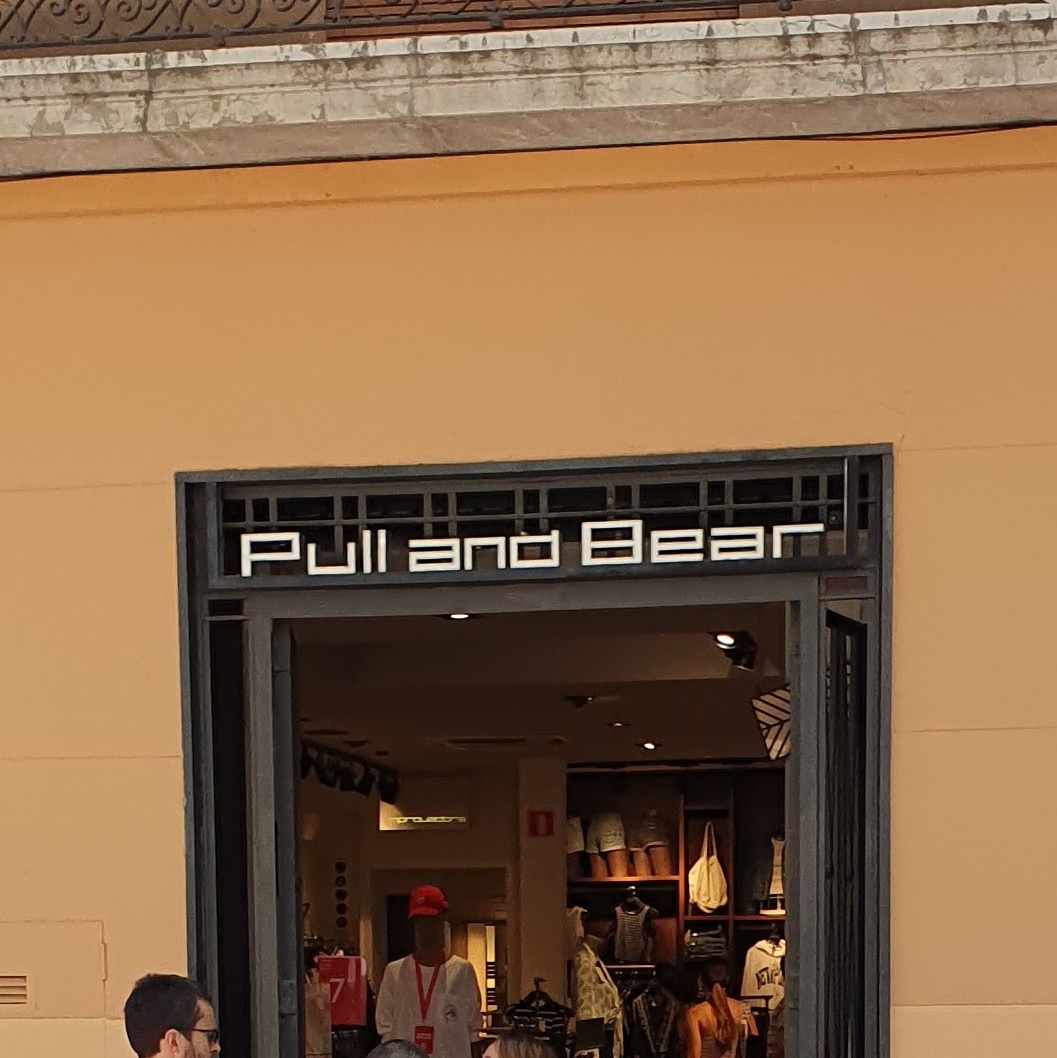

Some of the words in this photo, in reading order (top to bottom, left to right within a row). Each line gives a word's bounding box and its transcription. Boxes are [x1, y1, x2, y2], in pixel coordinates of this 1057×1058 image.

[241, 529, 387, 577] Pull
[408, 530, 560, 572] and
[581, 518, 825, 566] Bear
